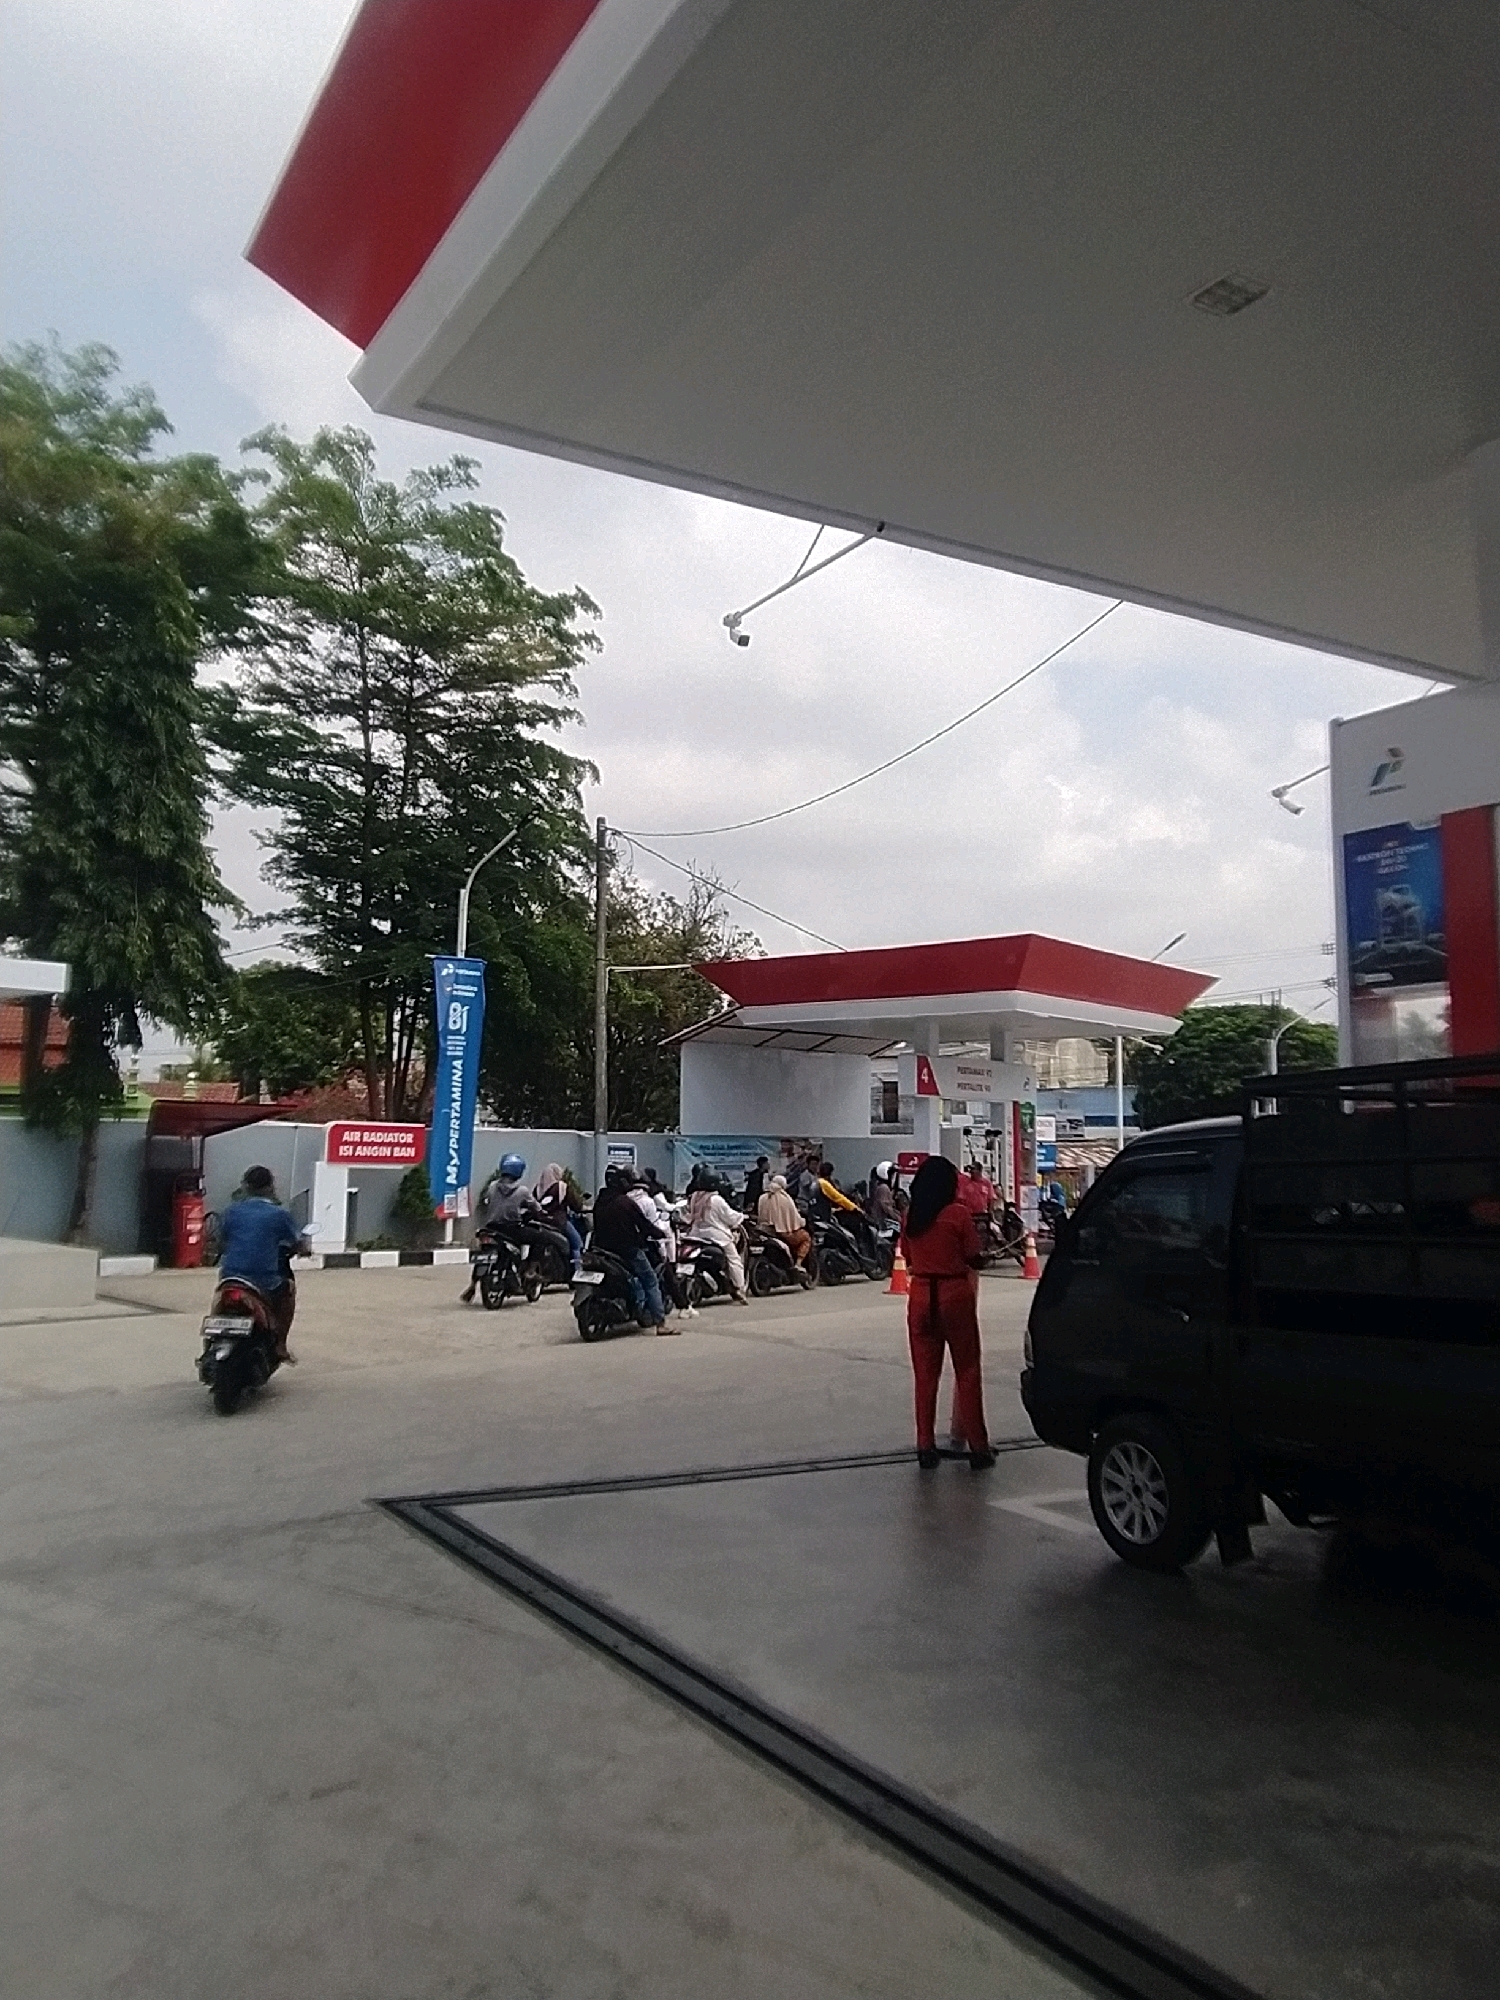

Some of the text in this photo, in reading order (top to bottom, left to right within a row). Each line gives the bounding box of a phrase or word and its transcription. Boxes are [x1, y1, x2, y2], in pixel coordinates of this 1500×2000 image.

[921, 1067, 929, 1083] 4
[342, 1131, 414, 1143] AIR RADIATOR
[338, 1145, 416, 1157] ISI ANGIN BAN
